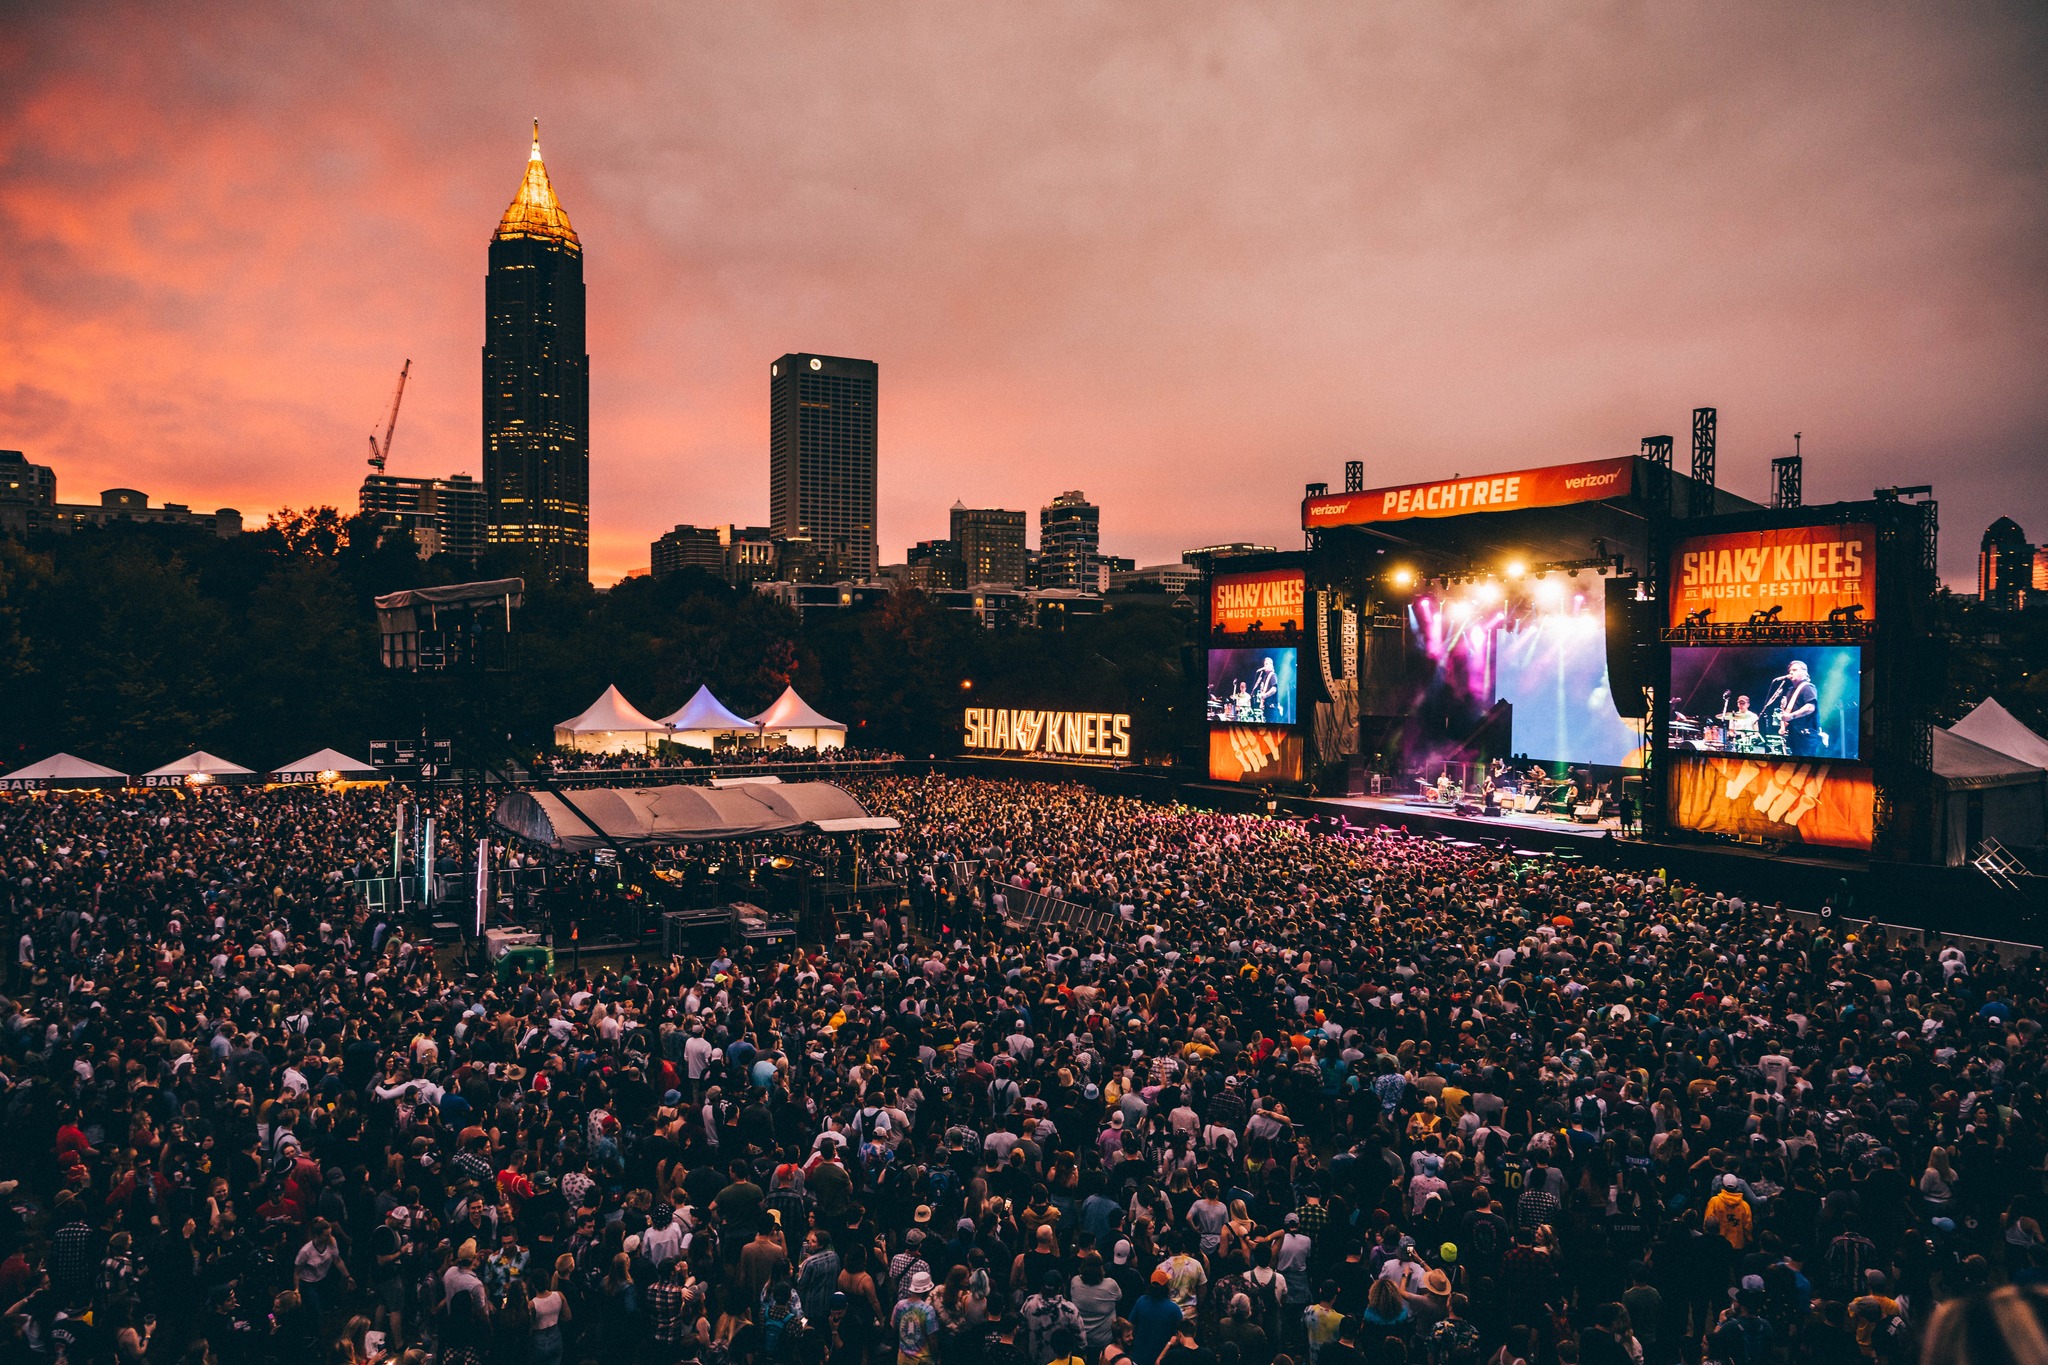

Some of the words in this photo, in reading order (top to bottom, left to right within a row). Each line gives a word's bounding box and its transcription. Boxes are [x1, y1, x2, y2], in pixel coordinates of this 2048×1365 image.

[1565, 473, 1615, 490] verizon
[1382, 476, 1521, 515] PEACHTREE
[1310, 503, 1346, 515] verizon
[1683, 546, 1771, 586] SHAKY
[1773, 540, 1862, 581] KNEES
[1217, 582, 1262, 609] SHAKY
[1262, 579, 1304, 606] KNEES
[1685, 589, 1698, 598] ATL
[1702, 585, 1752, 599] MUSIC
[1759, 580, 1840, 597] FESTIVAL
[1844, 582, 1860, 591] GA
[1226, 608, 1254, 619] MUSIC
[1256, 606, 1294, 617] FESTIVAL
[964, 707, 1046, 751] SHAKY
[1045, 711, 1131, 757] KNEES
[0, 780, 36, 791] BAR
[145, 776, 182, 787] BAR
[281, 772, 315, 783] BAR
[1503, 1170, 1523, 1189] 10
